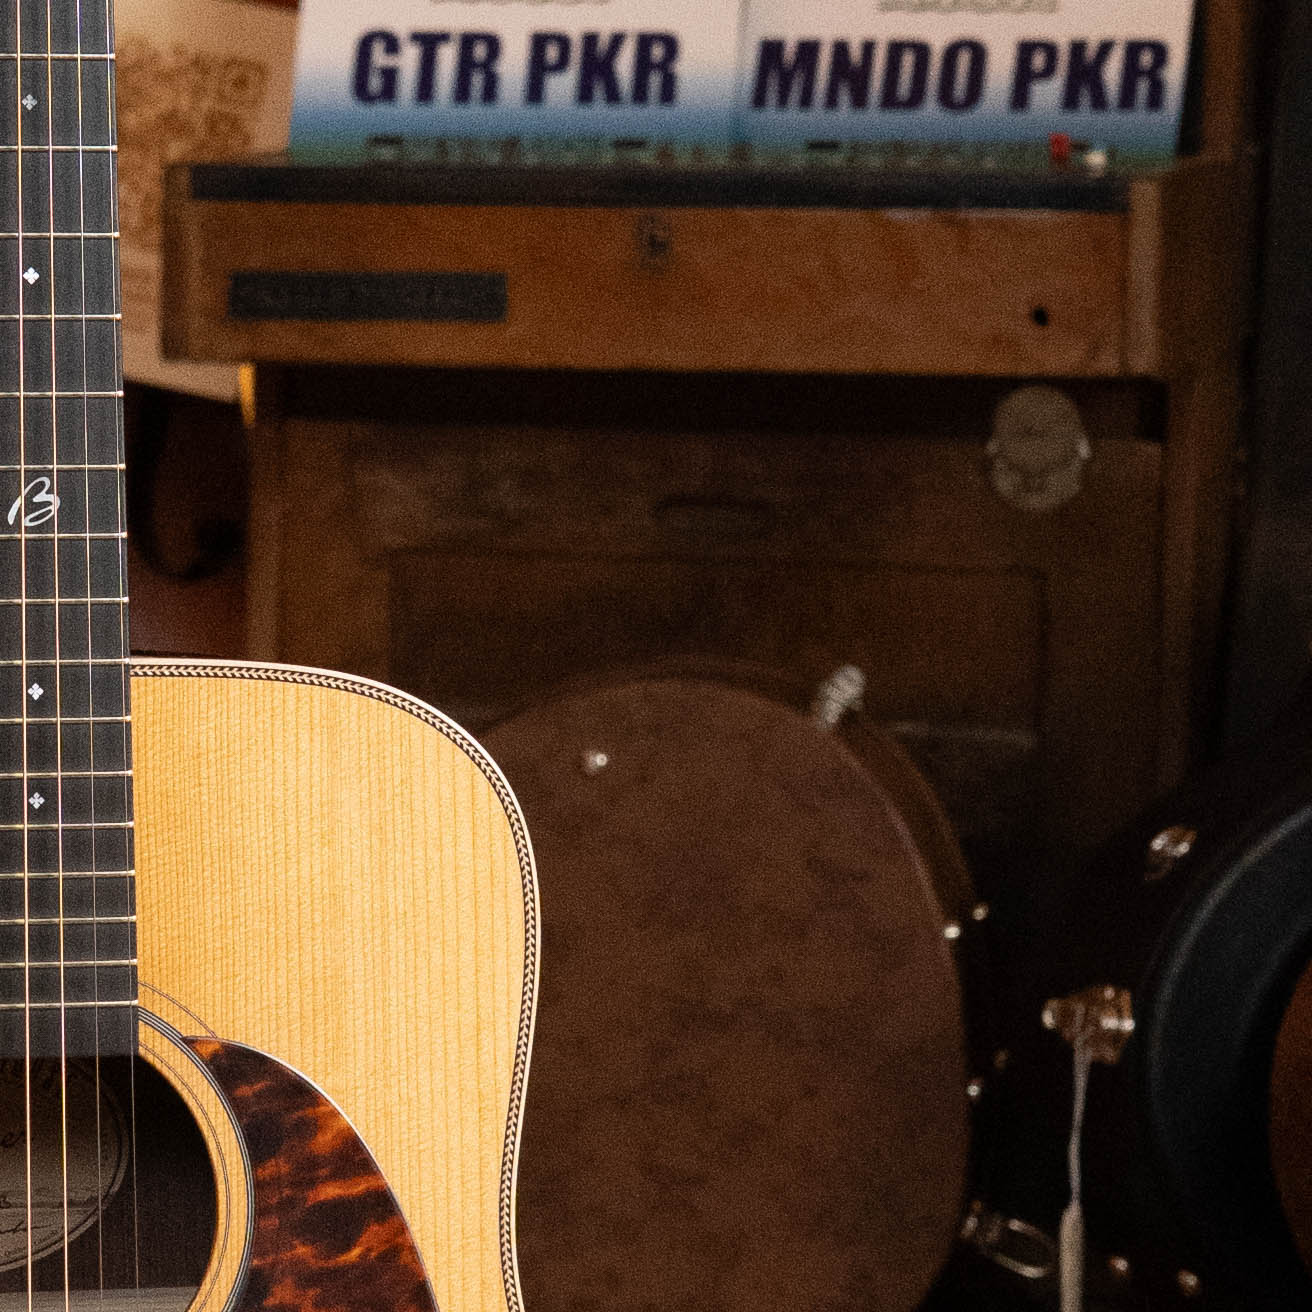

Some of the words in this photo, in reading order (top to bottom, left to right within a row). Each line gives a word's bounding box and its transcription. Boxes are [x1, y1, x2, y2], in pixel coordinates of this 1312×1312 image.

[352, 29, 502, 106] GTR
[524, 31, 682, 106] PKR
[750, 37, 988, 112] MNDO
[1008, 38, 1169, 112] PKR
